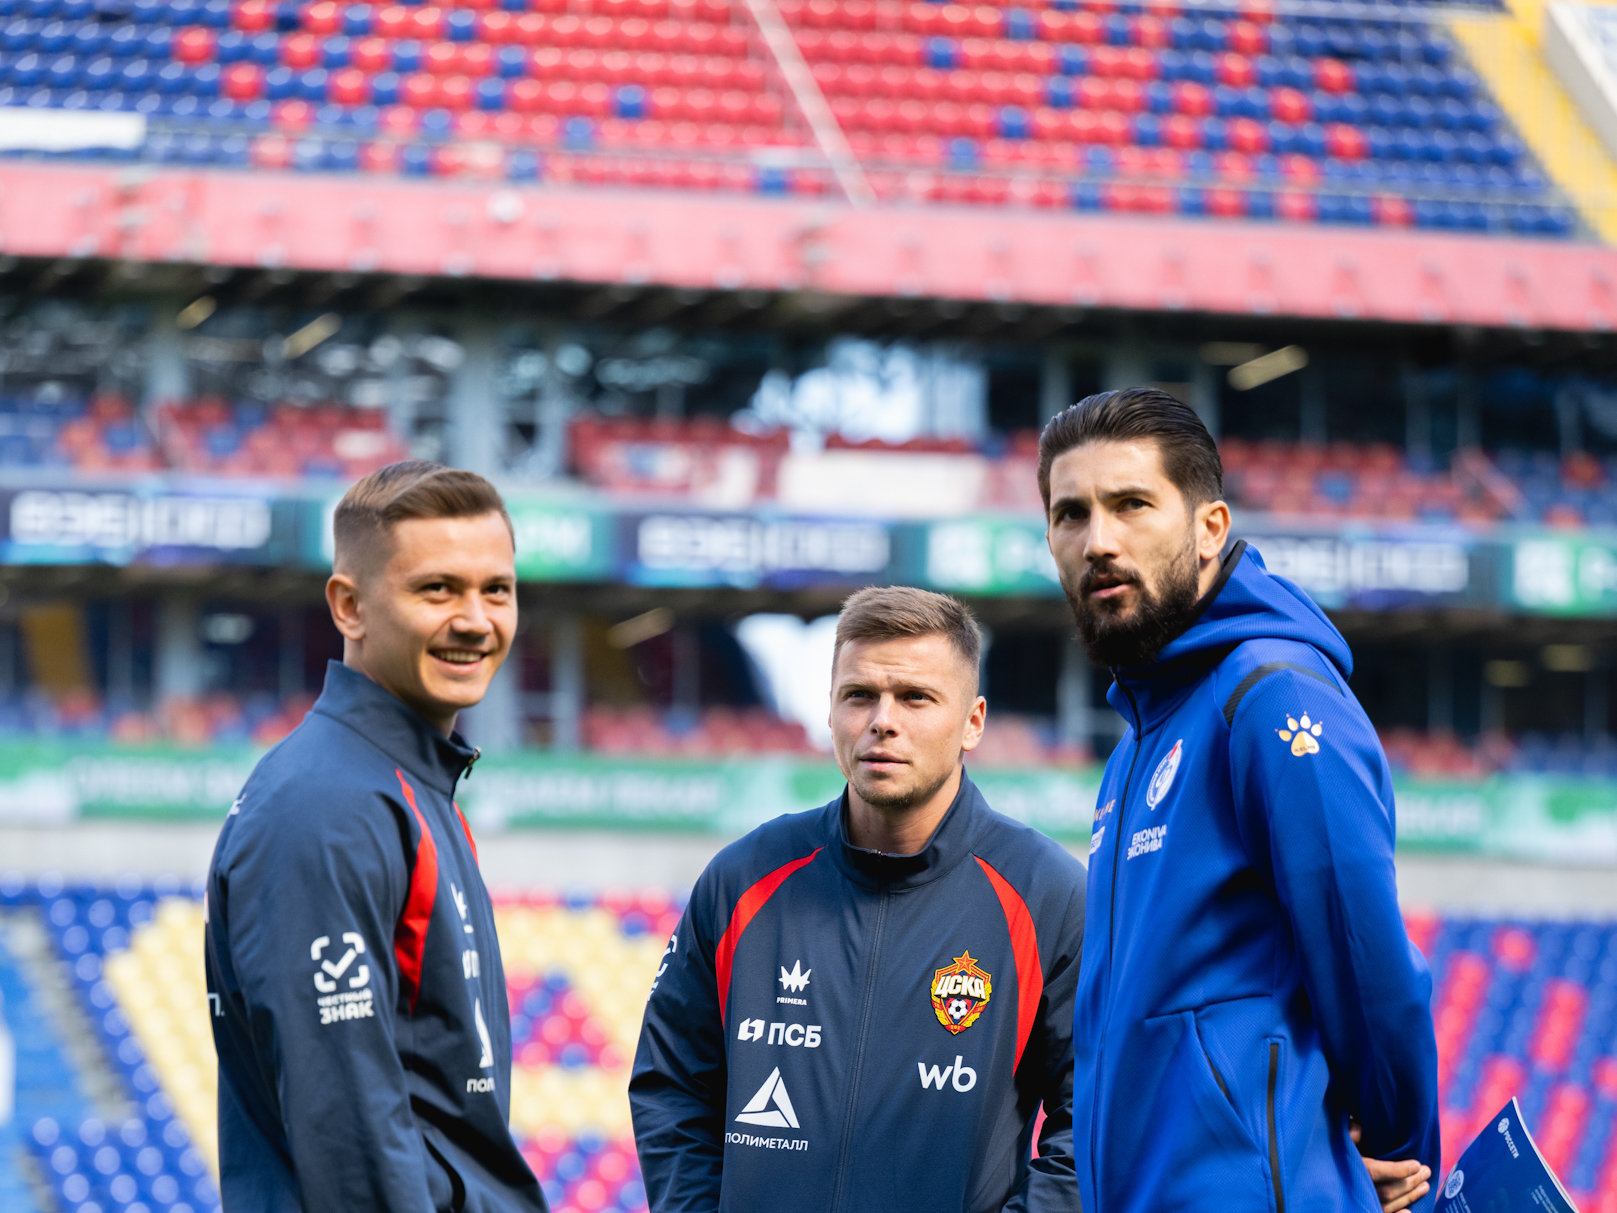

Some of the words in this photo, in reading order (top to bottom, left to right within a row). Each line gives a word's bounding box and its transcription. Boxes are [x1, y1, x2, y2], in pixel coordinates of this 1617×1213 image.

[934, 974, 987, 1000] ЦСКА
[319, 1000, 375, 1025] ЗНАК
[776, 996, 808, 1006] PRIMERA
[767, 1022, 822, 1049] ПСБ
[917, 1054, 977, 1093] wb
[724, 1132, 809, 1151] ПОЛИМЕТАЛЛ
